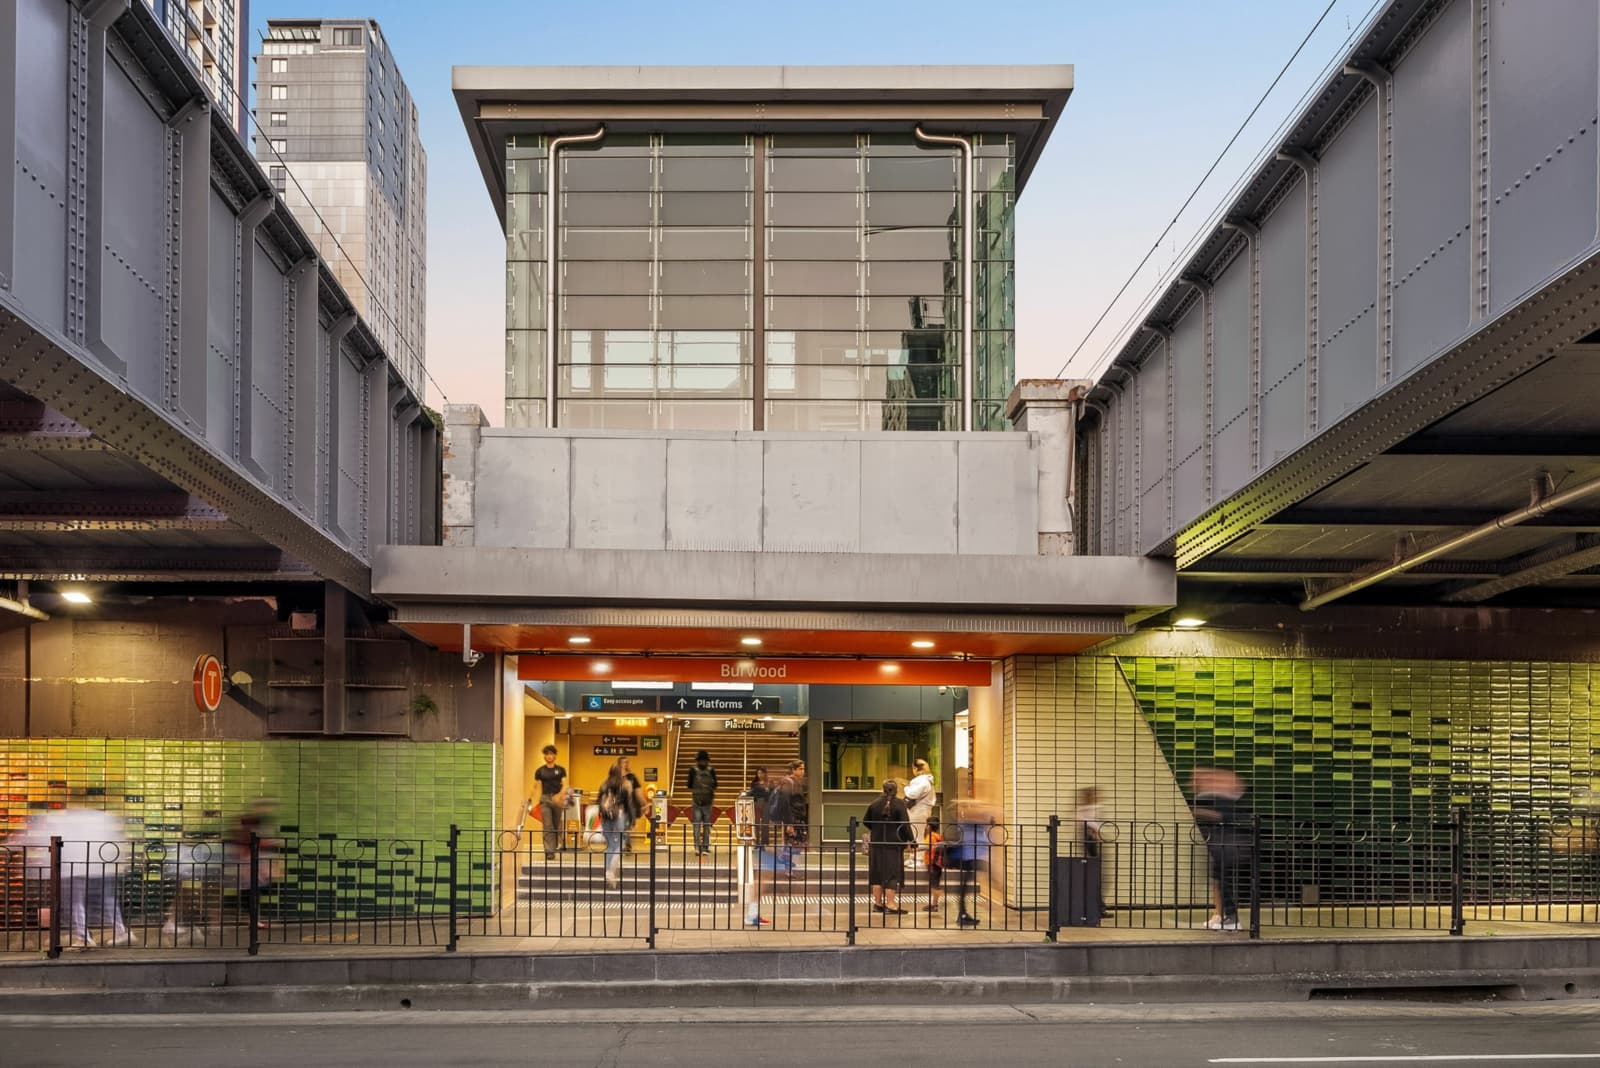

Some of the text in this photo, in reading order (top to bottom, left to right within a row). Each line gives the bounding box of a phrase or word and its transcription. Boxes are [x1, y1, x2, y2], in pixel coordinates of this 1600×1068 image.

[721, 663, 786, 678] Burwood
[208, 671, 217, 700] T
[696, 699, 743, 709] Platforms
[684, 720, 691, 729] 2
